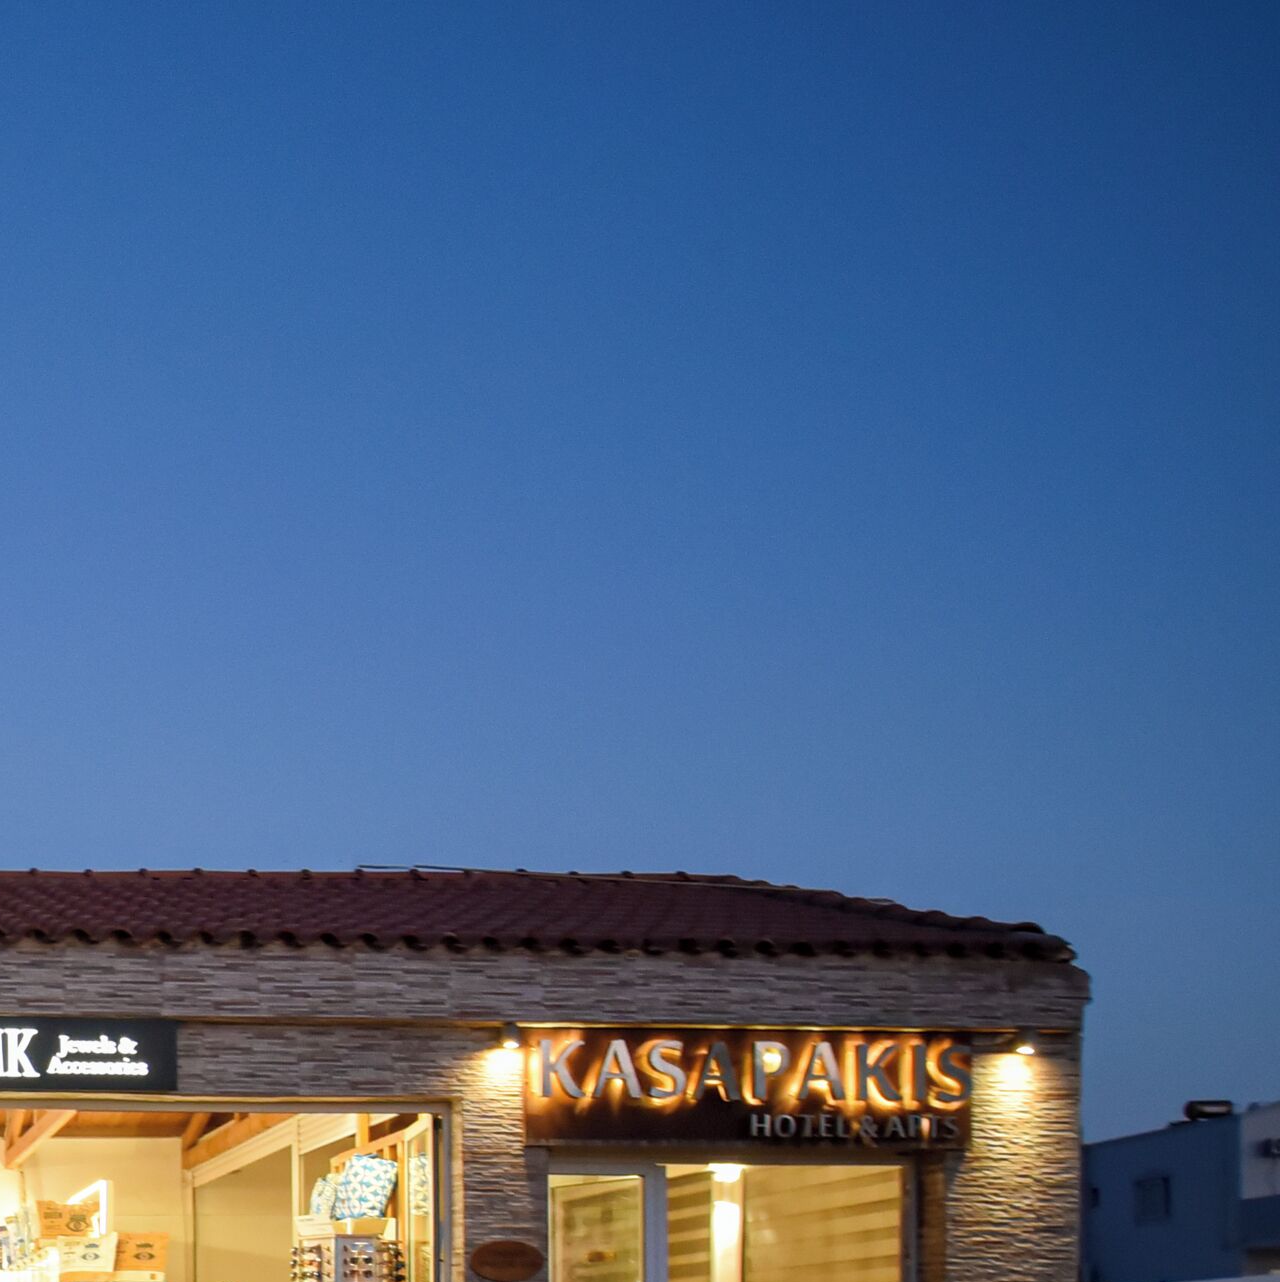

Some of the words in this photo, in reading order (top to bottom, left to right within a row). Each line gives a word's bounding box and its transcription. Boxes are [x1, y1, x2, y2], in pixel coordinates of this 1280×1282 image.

[56, 1035, 117, 1058] Jewels
[118, 1037, 138, 1054] &
[46, 1056, 149, 1076] Accessories
[540, 1038, 972, 1104] KASAPAKIS
[750, 1113, 850, 1138] HOTEL
[859, 1113, 879, 1138] &
[884, 1113, 961, 1139] APTS
